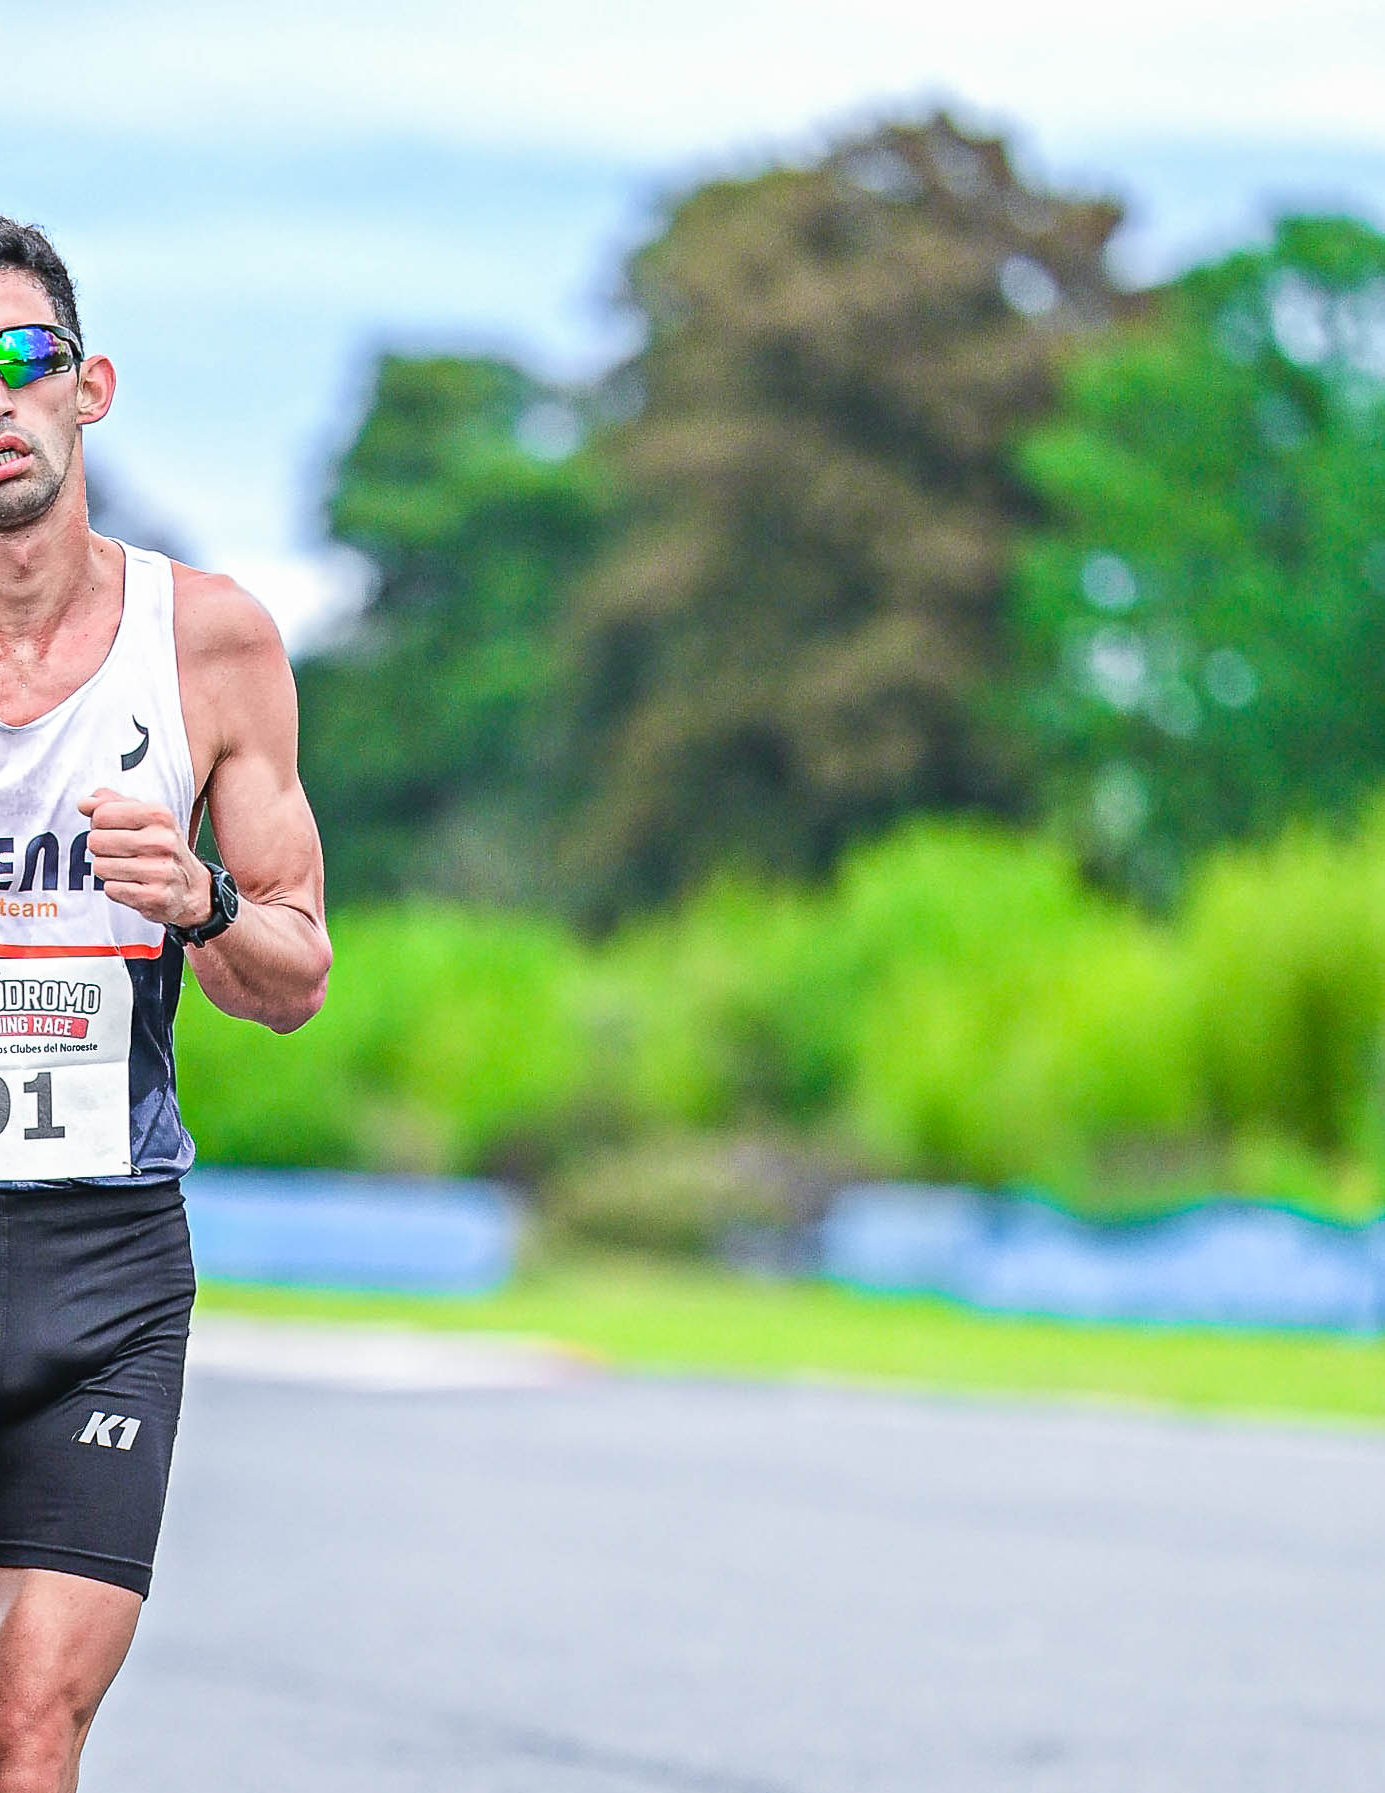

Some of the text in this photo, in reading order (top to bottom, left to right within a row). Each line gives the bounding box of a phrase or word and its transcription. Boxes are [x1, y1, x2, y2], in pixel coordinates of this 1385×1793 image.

[32, 1016, 73, 1036] RACE
[9, 1044, 42, 1054] Clubes
[43, 1043, 58, 1053] del
[59, 1043, 98, 1053] Noroeste
[78, 1411, 142, 1451] K1
